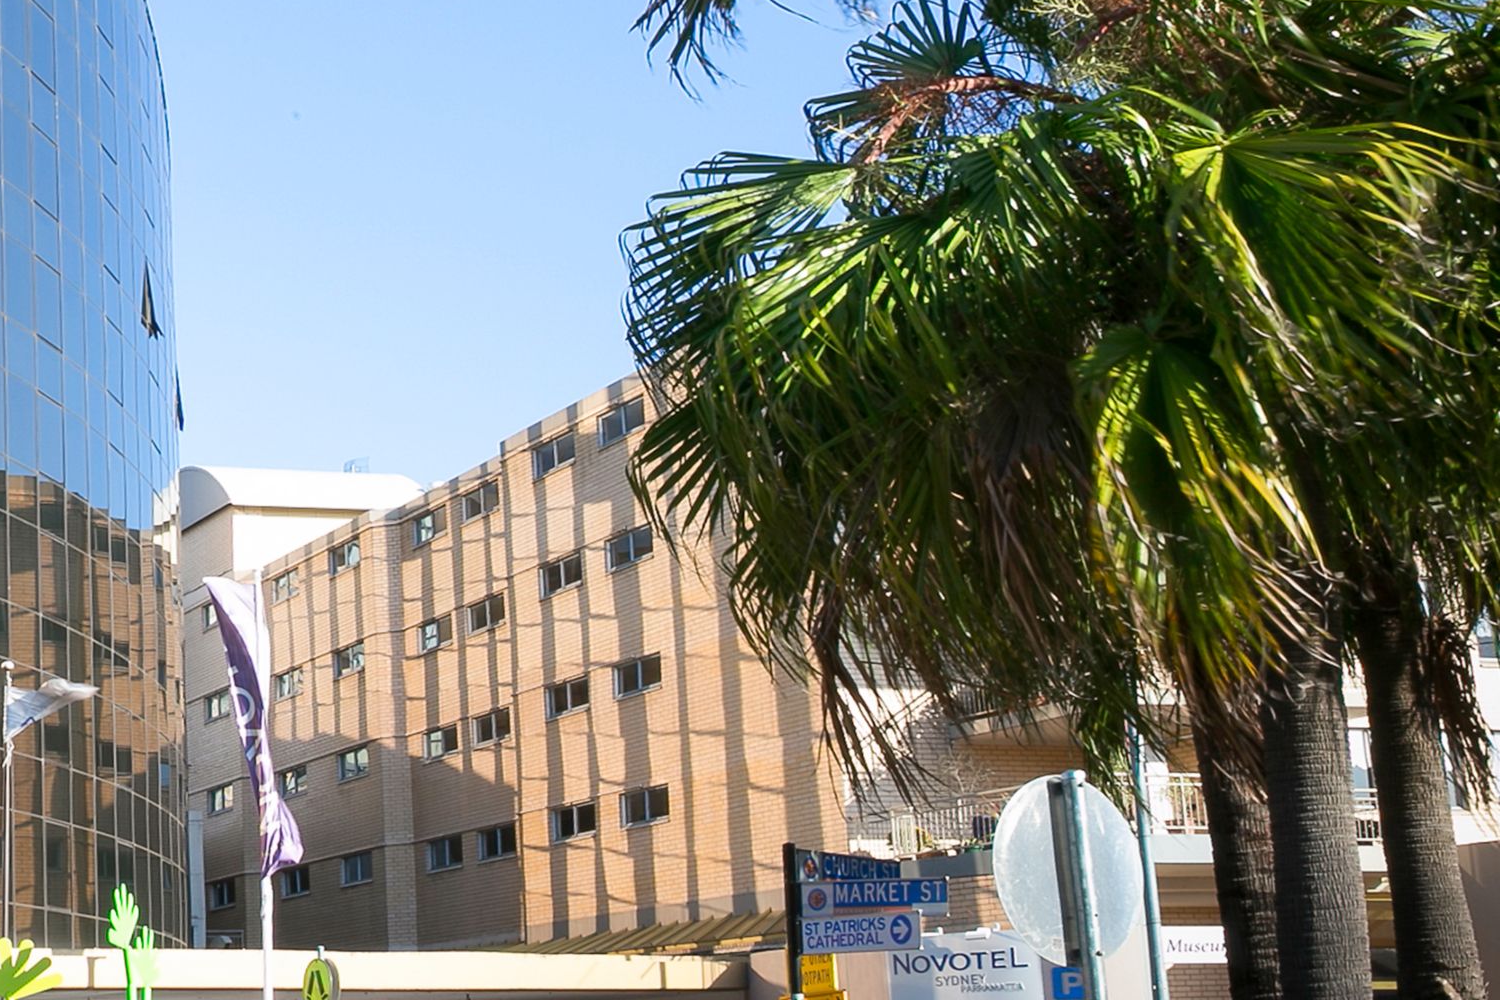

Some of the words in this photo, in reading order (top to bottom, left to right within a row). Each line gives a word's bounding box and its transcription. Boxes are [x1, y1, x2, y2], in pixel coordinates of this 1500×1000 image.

[823, 856, 877, 879] CHURCH
[883, 863, 897, 879] ST
[835, 882, 911, 903] MARKET
[920, 880, 943, 902] ST
[804, 922, 820, 936] ST
[824, 917, 887, 935] PATRICKS
[806, 931, 885, 949] CATHEDRAL
[893, 947, 1029, 975] NOVOTEL
[935, 974, 986, 988] SYDNEY
[1061, 971, 1083, 995] P
